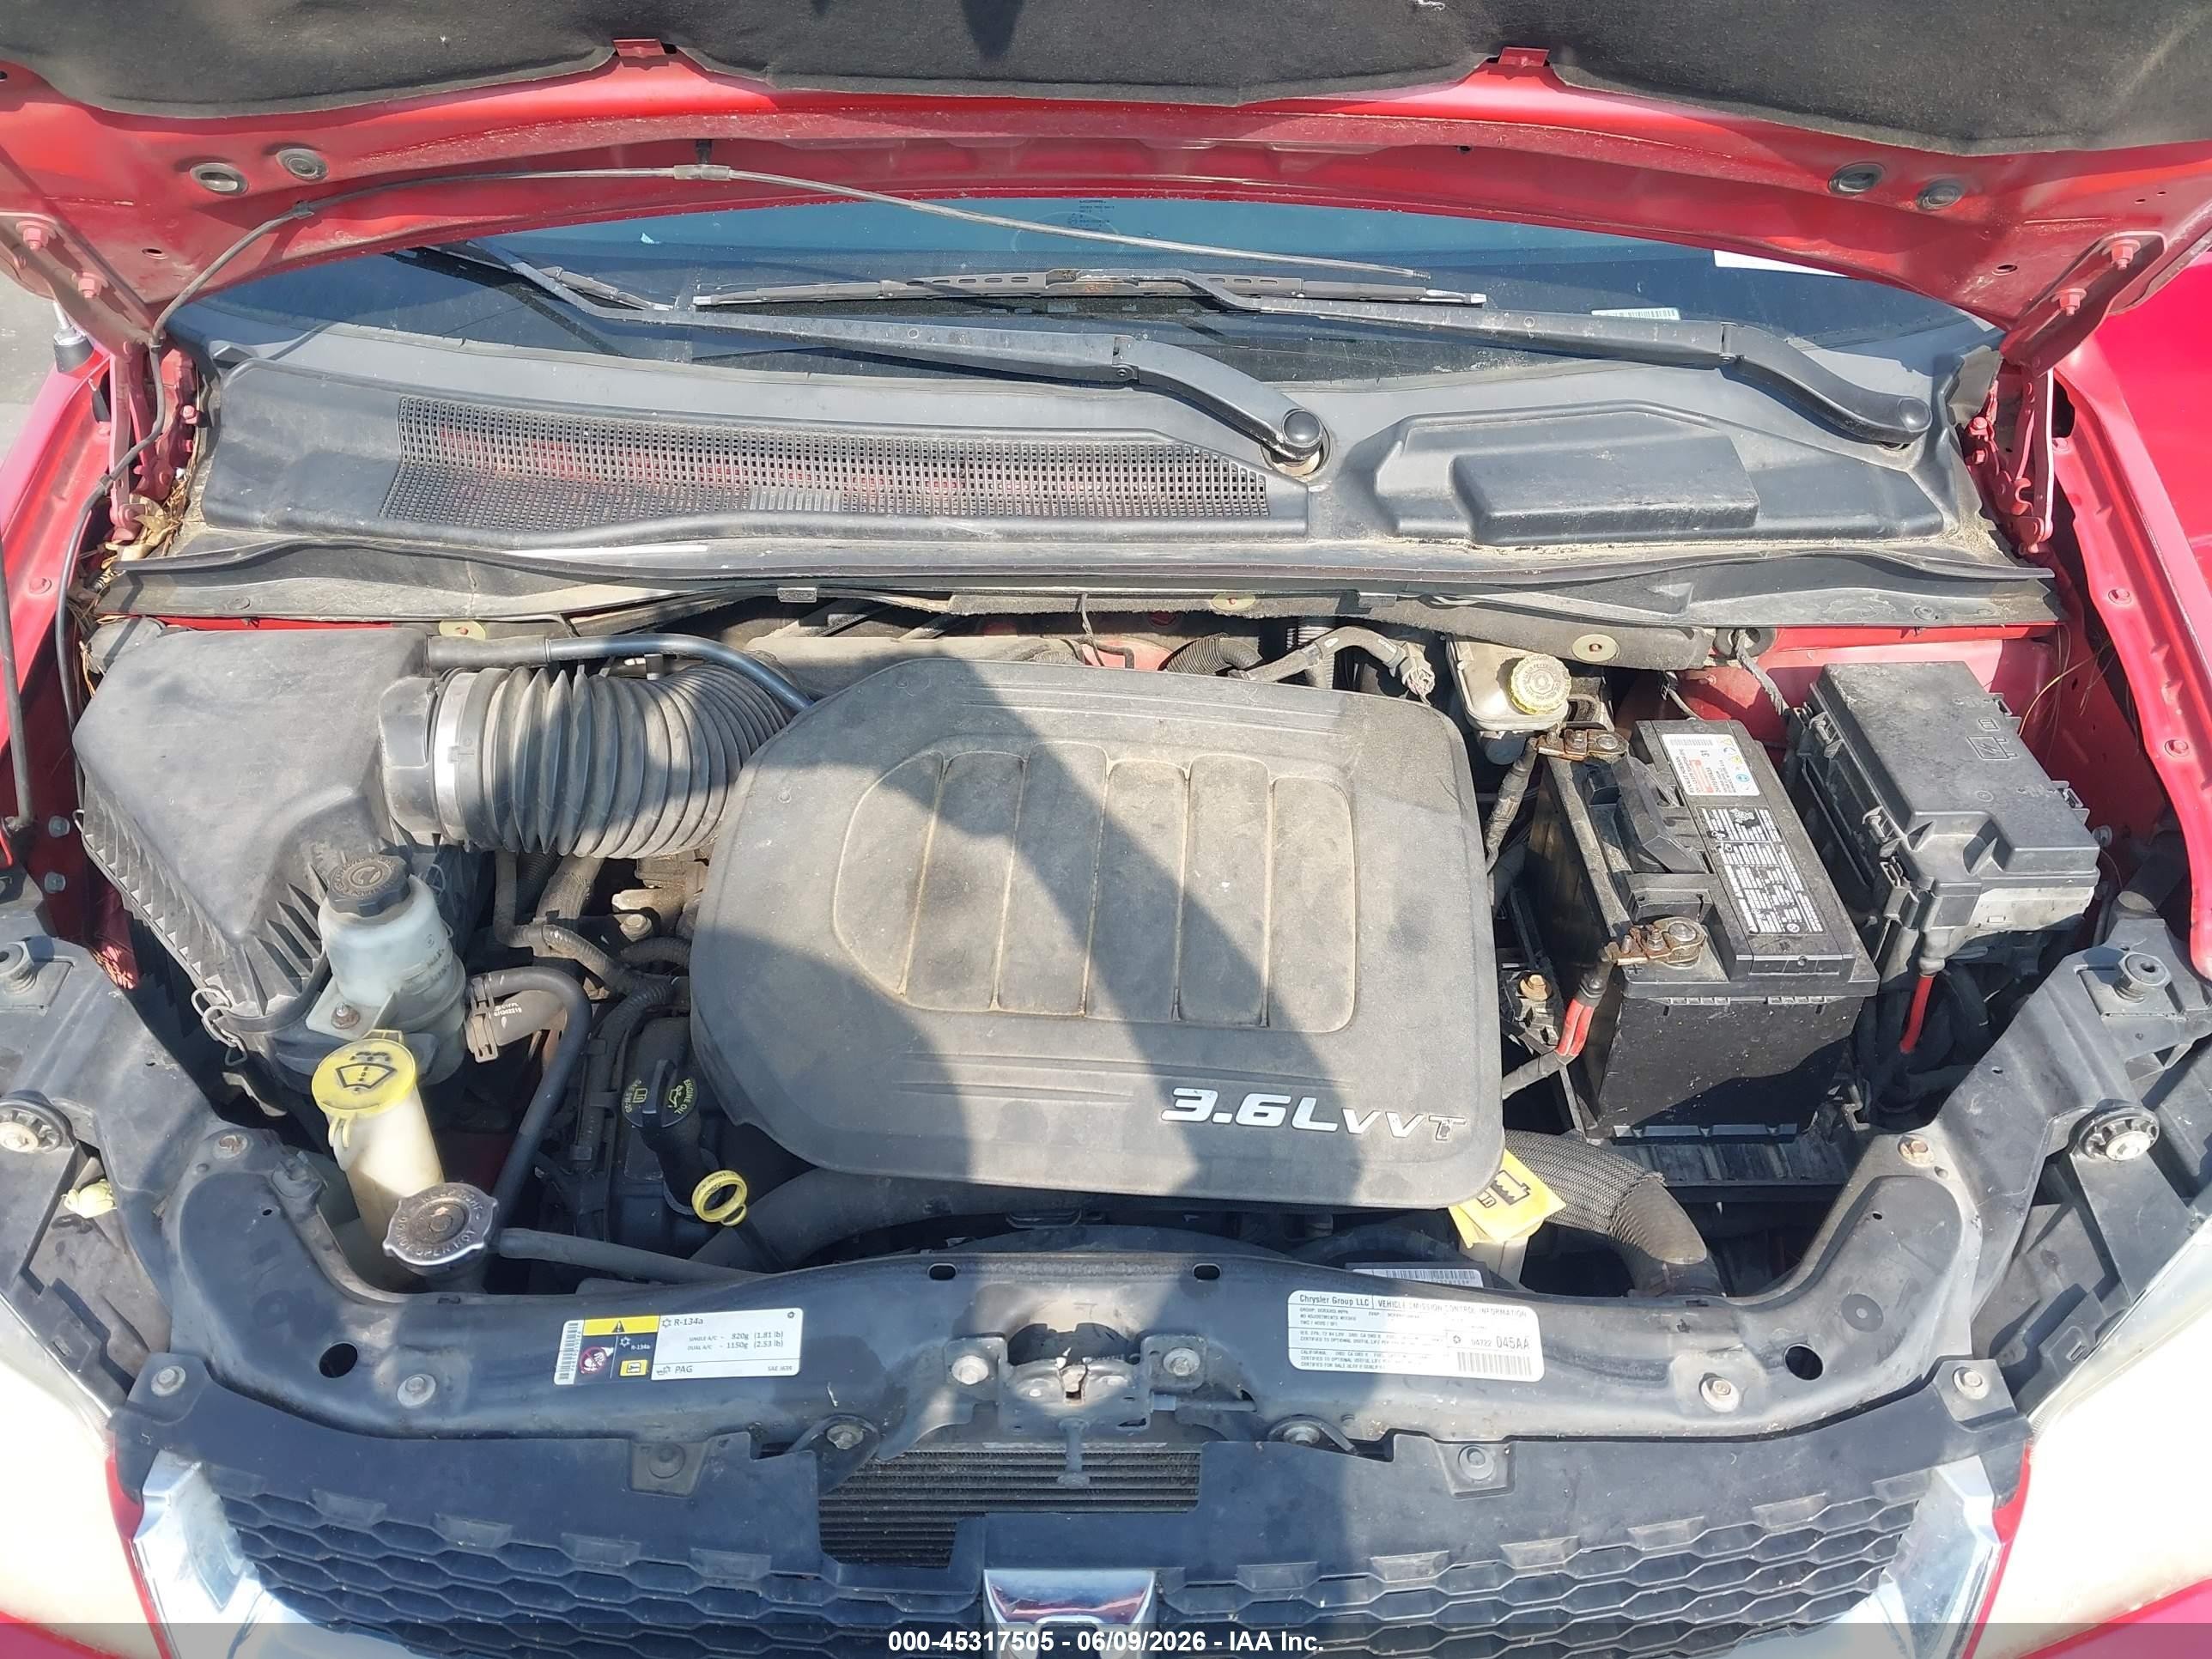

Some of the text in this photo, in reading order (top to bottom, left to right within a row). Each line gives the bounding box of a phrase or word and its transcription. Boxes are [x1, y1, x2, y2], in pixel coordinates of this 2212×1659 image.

[674, 1079, 694, 1115] ENGINE OIL
[1341, 1107, 1468, 1141] VVT
[415, 1245, 451, 1257] OPEN
[453, 1230, 476, 1249] HOT
[1299, 1294, 1329, 1304] Chrysler
[1332, 1297, 1353, 1306] Group
[1377, 1300, 1527, 1317] VEHICLE EMISSION CONTROL INFORMATION
[674, 1317, 703, 1327] R-134a
[754, 1331, 772, 1340] (1.81
[774, 1330, 783, 1339] lb)
[726, 1341, 749, 1350] 1150g
[754, 1340, 772, 1348] (2.53
[774, 1339, 783, 1347] lb)
[1496, 1336, 1530, 1350] 045AA
[675, 1365, 693, 1374] PAG
